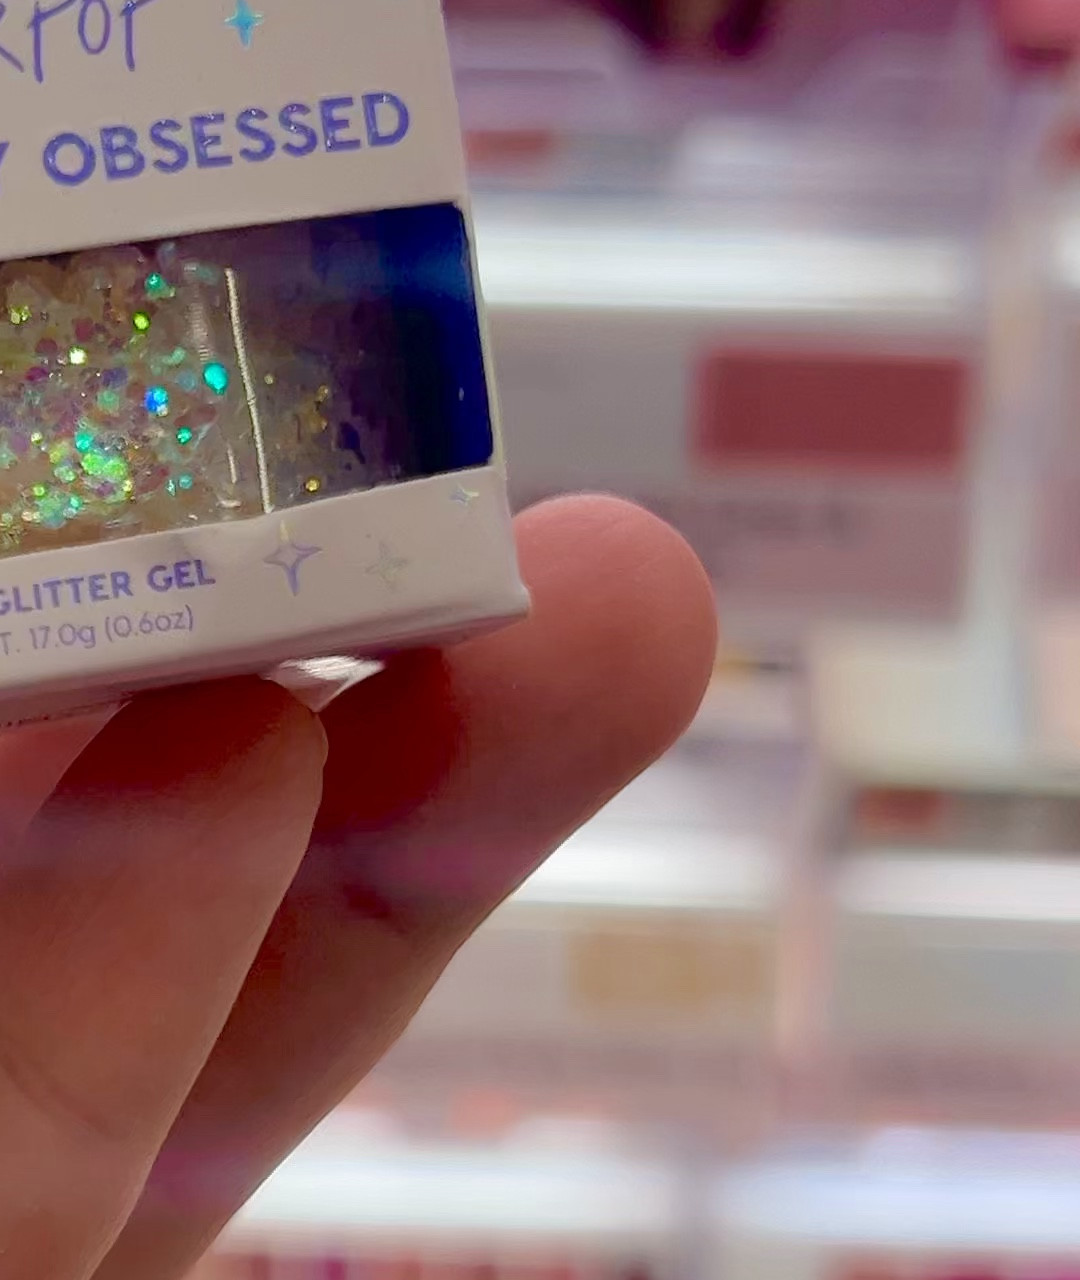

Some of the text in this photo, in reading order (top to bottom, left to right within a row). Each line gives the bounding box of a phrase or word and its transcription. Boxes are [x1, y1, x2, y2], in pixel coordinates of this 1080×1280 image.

[41, 90, 411, 187] OBSESSED
[146, 558, 217, 593] GEL
[28, 623, 96, 650] 17.0g
